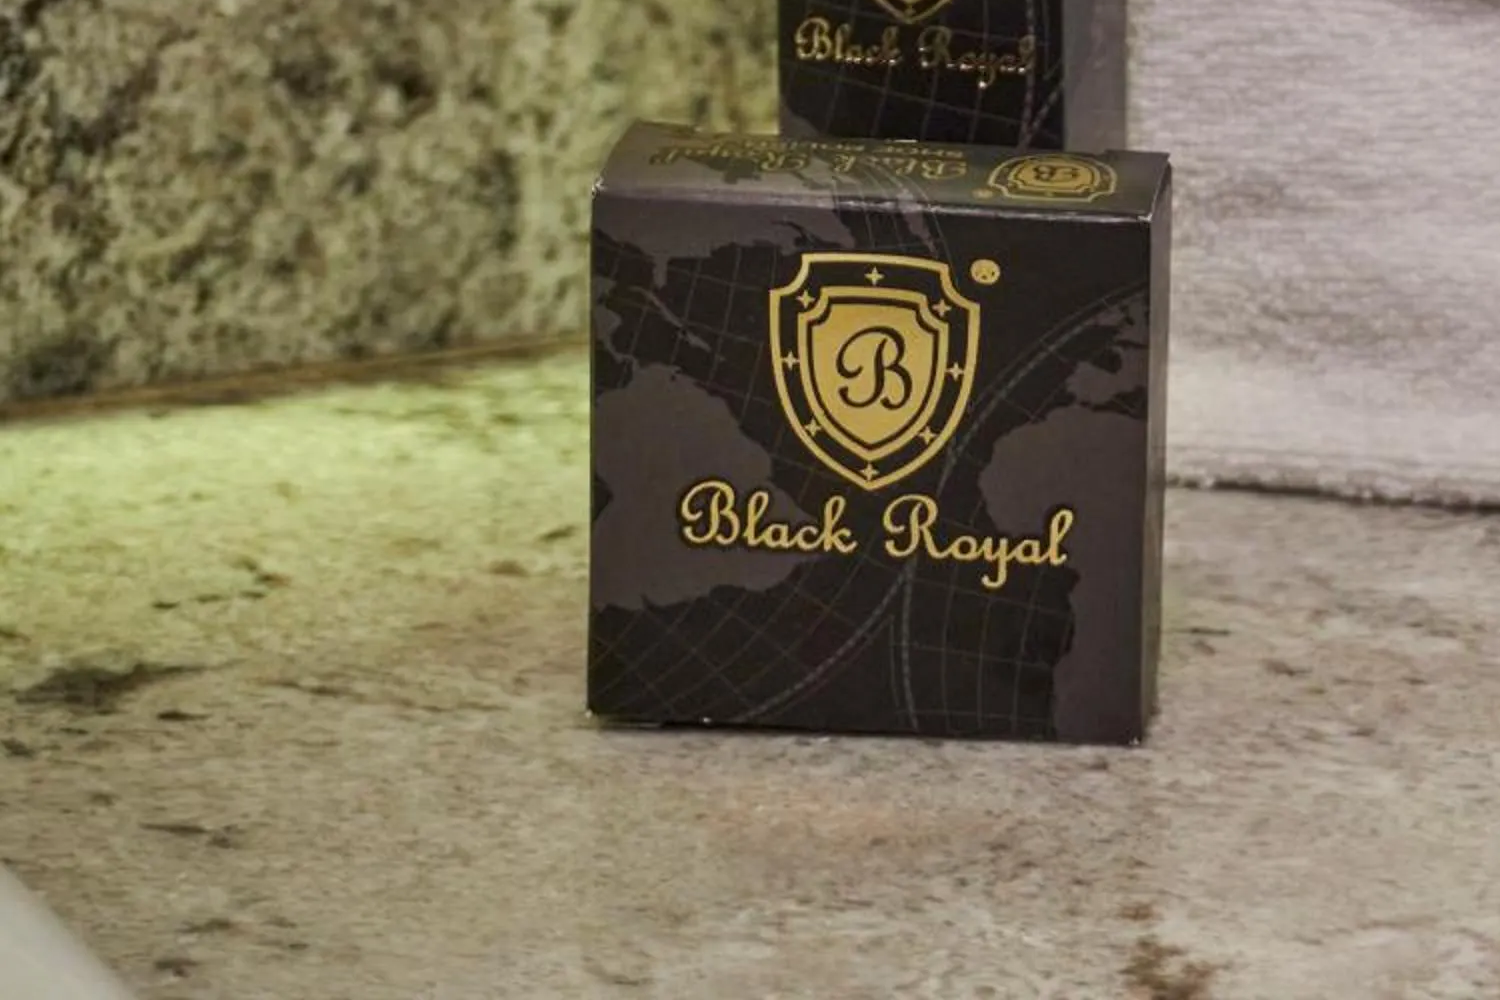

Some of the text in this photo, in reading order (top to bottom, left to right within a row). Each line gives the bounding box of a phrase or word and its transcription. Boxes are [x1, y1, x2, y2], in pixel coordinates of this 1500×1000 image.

[793, 16, 1036, 90] Black Royal
[835, 325, 914, 411] B
[678, 479, 1075, 589] Black Royal
